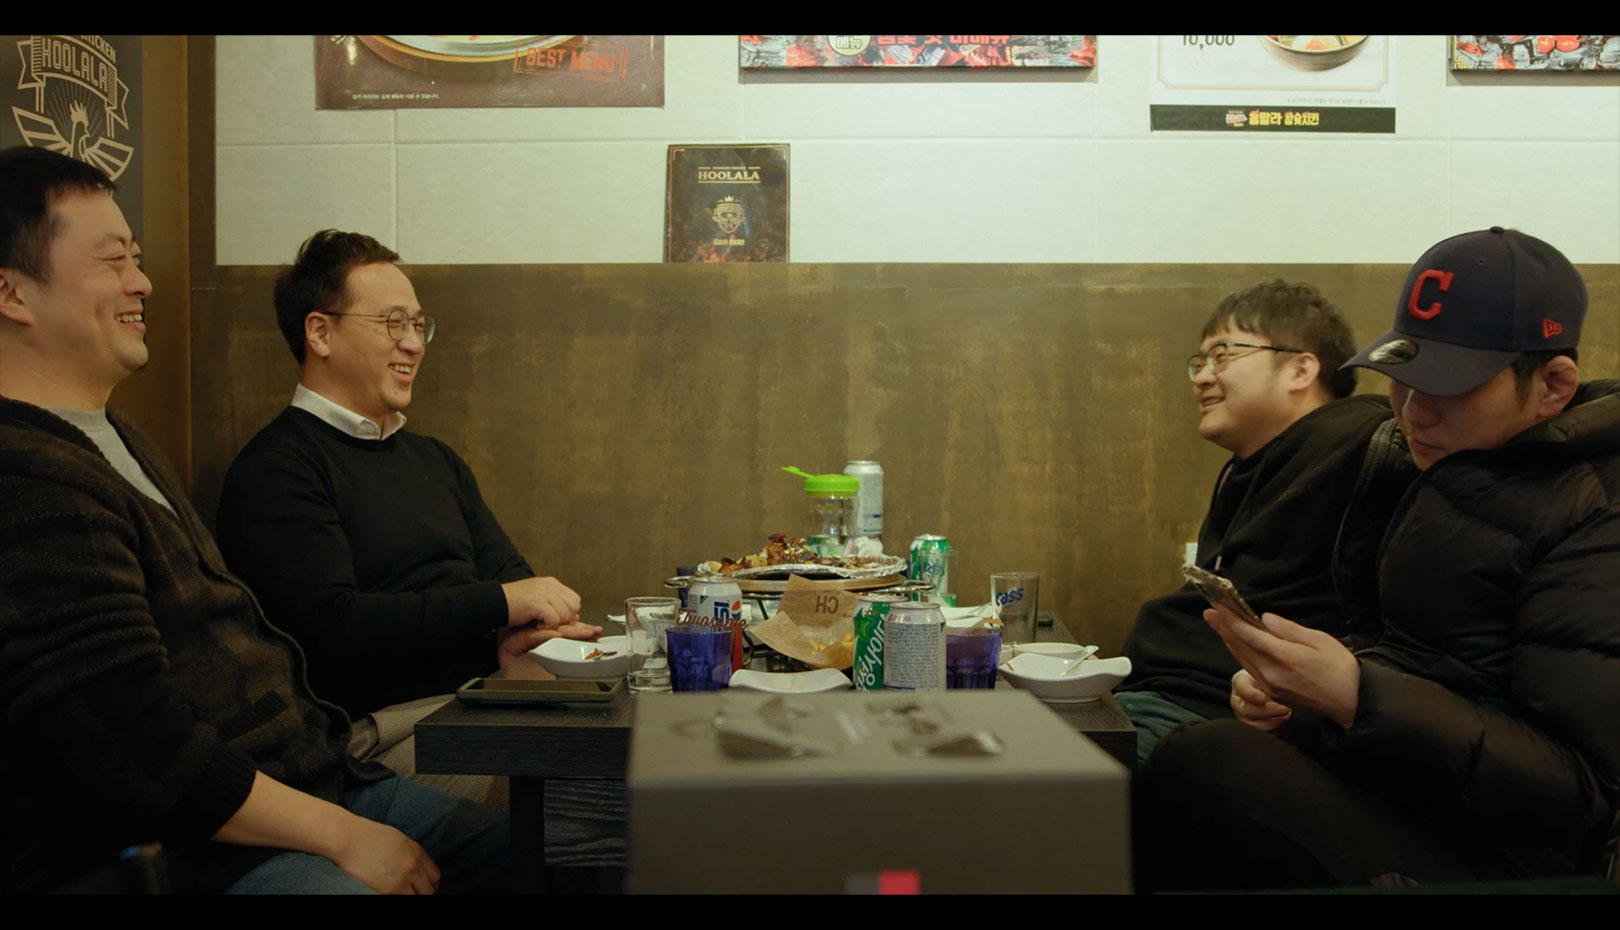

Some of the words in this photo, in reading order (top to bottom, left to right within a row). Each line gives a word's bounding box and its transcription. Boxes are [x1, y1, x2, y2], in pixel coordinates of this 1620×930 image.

[80, 35, 116, 63] ICKEN
[1183, 35, 1235, 50] 10,000
[42, 37, 107, 93] HOOLALA
[526, 47, 567, 68] BEST
[570, 50, 617, 73] MENU
[698, 171, 760, 180] HOOLALA
[1408, 268, 1455, 321] C
